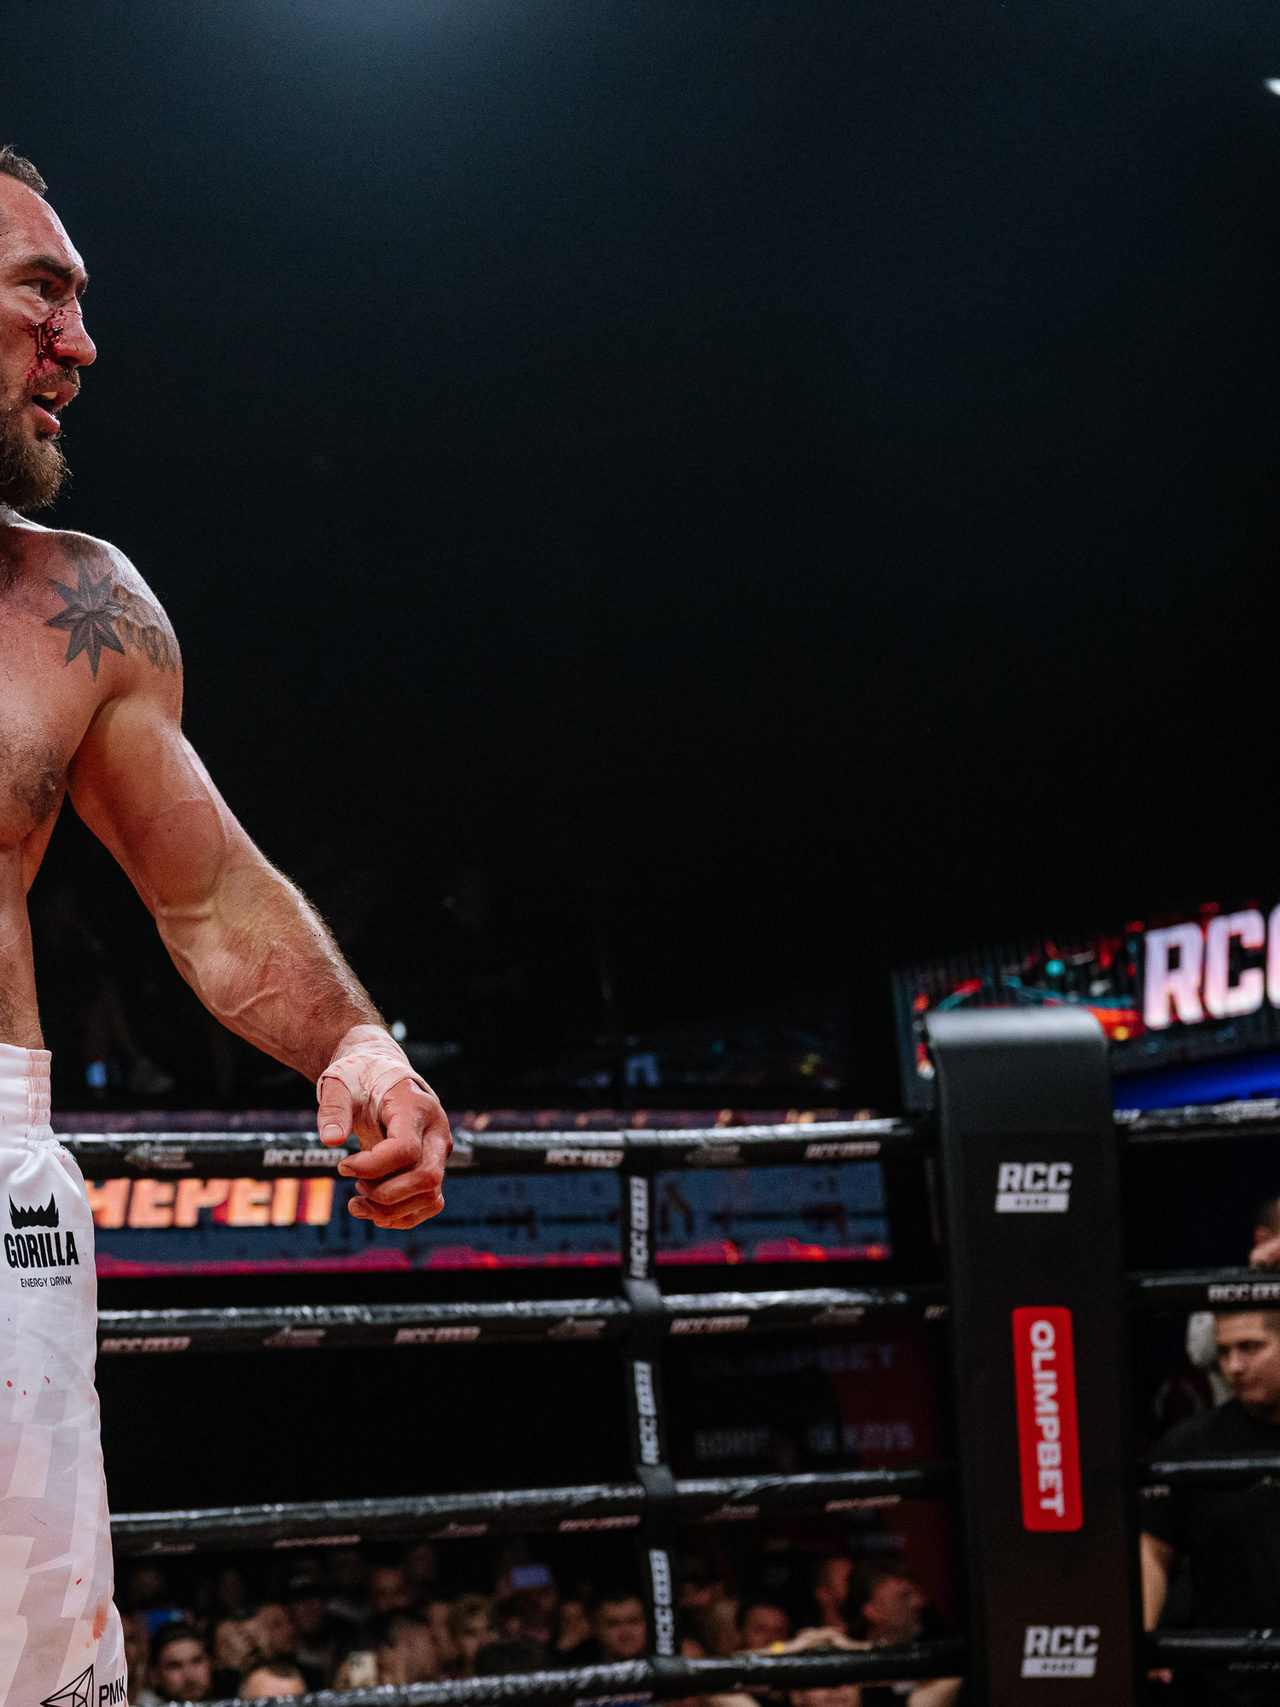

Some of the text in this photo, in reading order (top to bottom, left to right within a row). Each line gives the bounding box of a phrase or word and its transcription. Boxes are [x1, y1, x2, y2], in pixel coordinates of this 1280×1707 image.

[1144, 903, 1280, 1030] RC
[997, 1162, 1073, 1191] RCC
[4, 1231, 80, 1269] GORILLA
[20, 1275, 73, 1288] ENERGY DRINK
[1029, 1320, 1065, 1518] OLIMPBET
[1023, 1625, 1101, 1655] RCC
